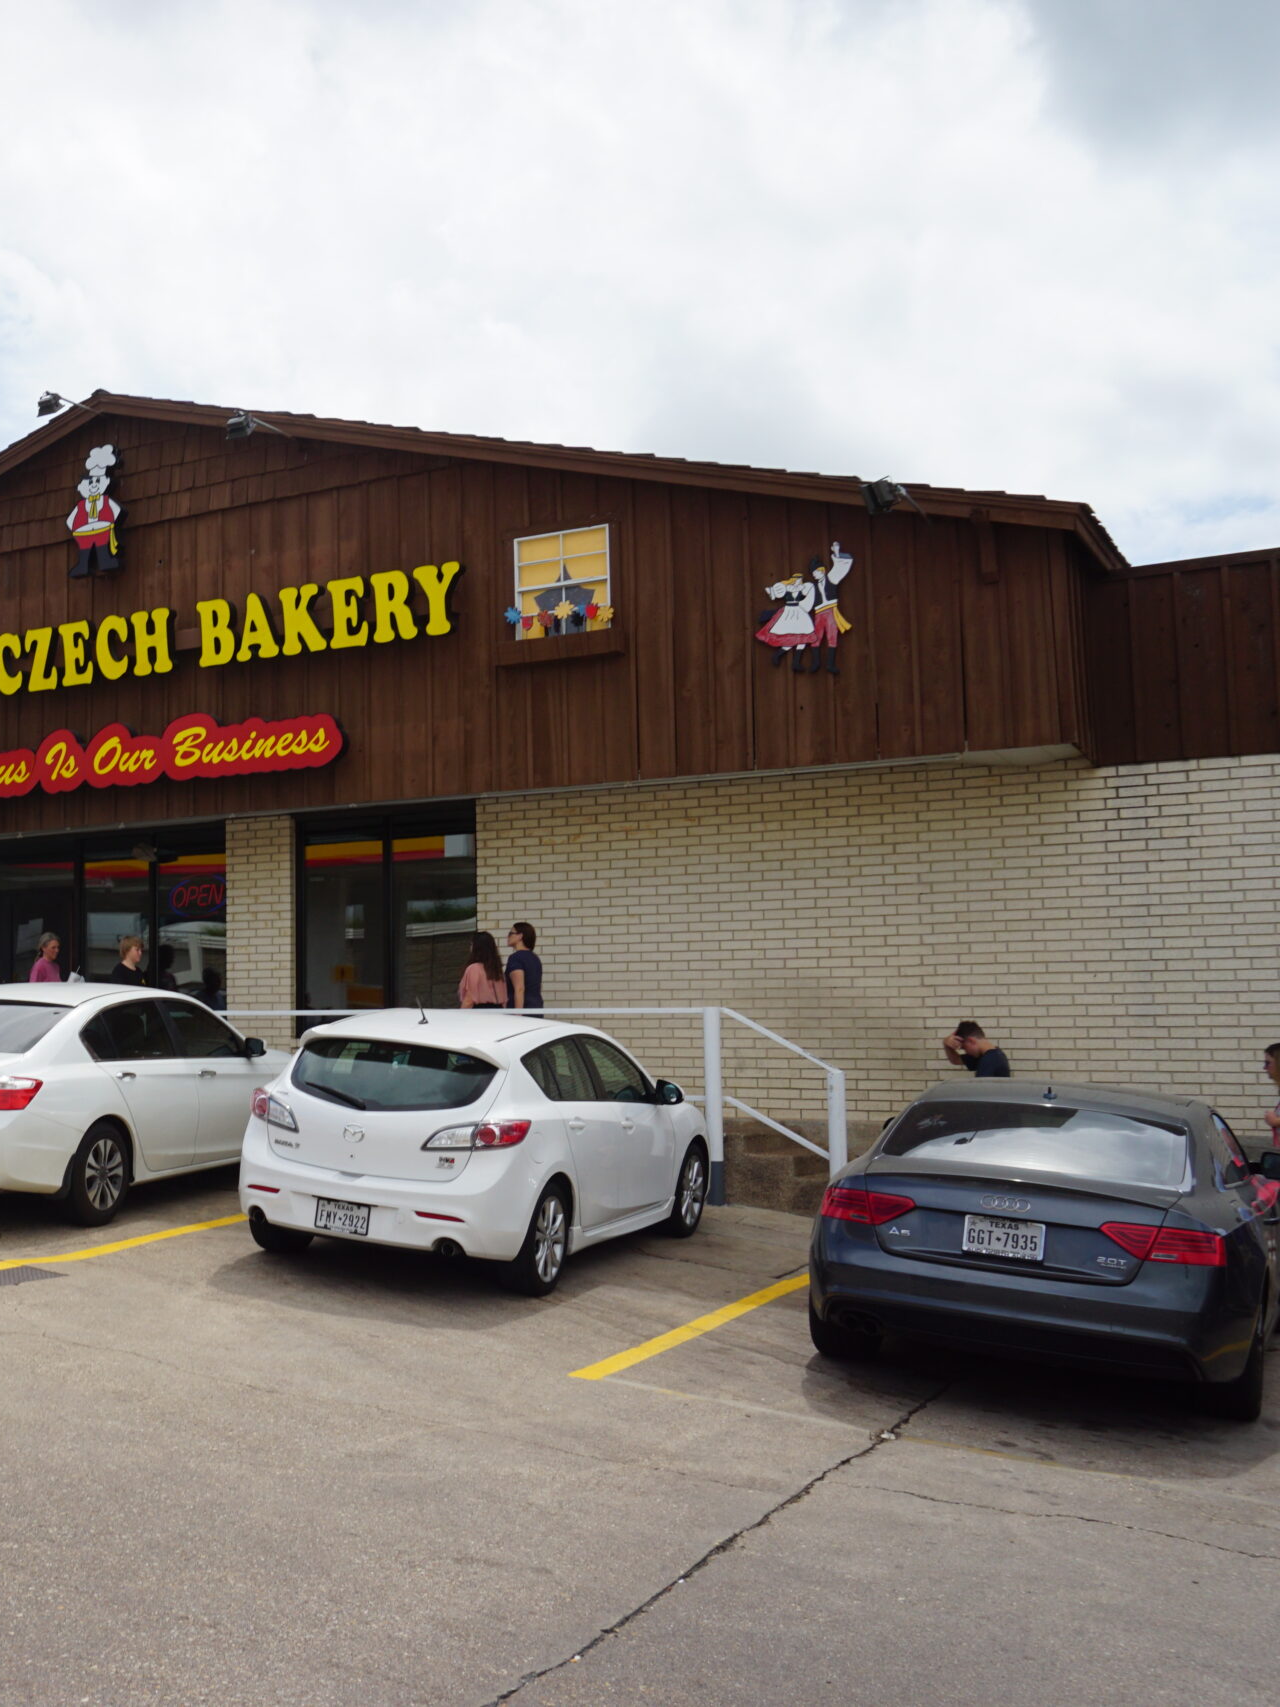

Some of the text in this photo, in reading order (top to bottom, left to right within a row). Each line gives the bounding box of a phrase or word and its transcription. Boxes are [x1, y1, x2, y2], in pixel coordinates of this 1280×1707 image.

[195, 560, 461, 669] BAKERY
[45, 742, 79, 780] Is
[93, 736, 157, 775] Our
[172, 726, 330, 768] Business
[173, 884, 224, 908] OPEN
[334, 1203, 354, 1212] TEXAS
[990, 1221, 1020, 1231] TEXAS
